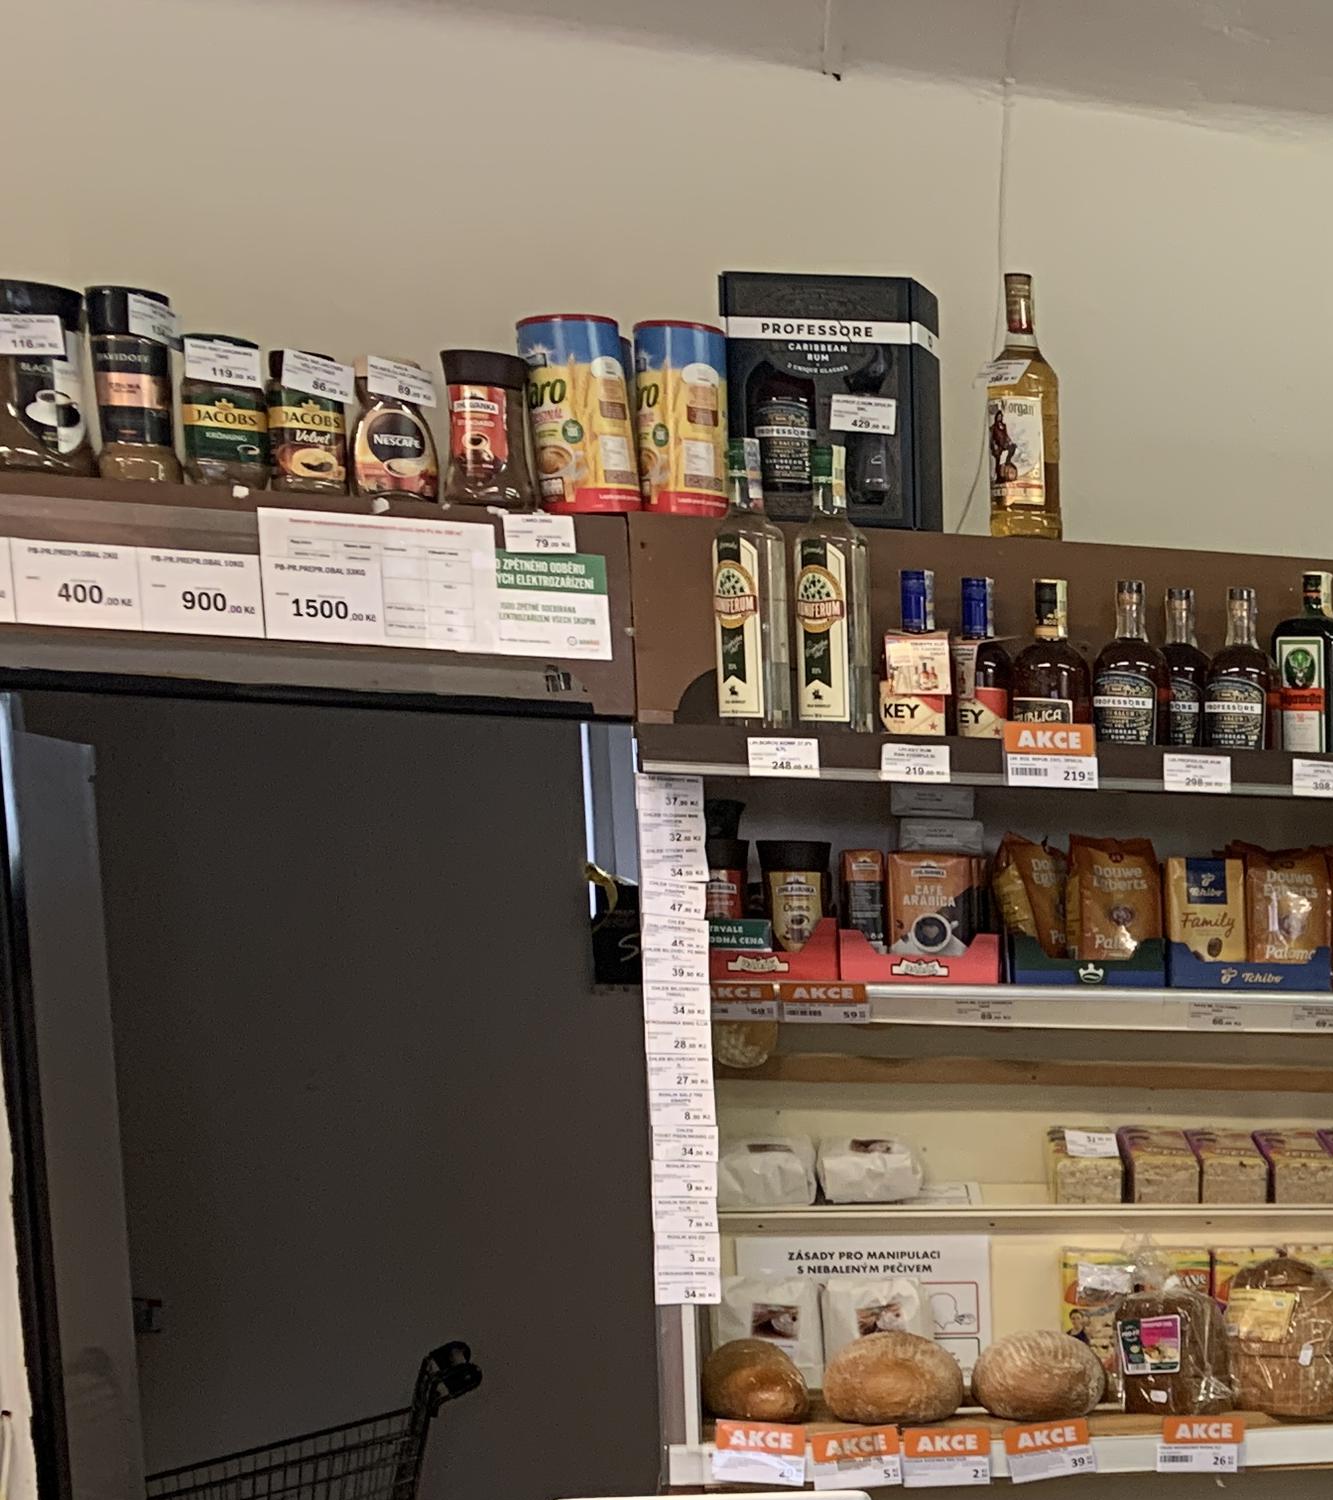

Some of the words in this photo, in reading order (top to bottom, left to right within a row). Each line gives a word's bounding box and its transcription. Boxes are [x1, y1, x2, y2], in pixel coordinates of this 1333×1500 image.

[761, 322, 873, 338] PROFESSORE
[788, 343, 848, 352] CARIBBEAN
[807, 353, 829, 362] RUM
[195, 409, 258, 427] JACOBS
[281, 410, 341, 428] JACOBS
[1017, 730, 1082, 750] AKCE
[903, 895, 956, 907] ARABICA
[1180, 911, 1237, 933] Family
[788, 1248, 836, 1261] ZÁSADY
[838, 1250, 864, 1261] PRO
[866, 1249, 941, 1261] MANIPULACI
[797, 1265, 804, 1274] S
[807, 1262, 877, 1274] NEBALENÝM
[880, 1262, 933, 1273] PEČIVEM
[1018, 1425, 1077, 1448] AKCE
[1174, 1423, 1234, 1440] AKCE
[916, 1431, 978, 1451] AKCE
[1213, 1454, 1227, 1466] 26
